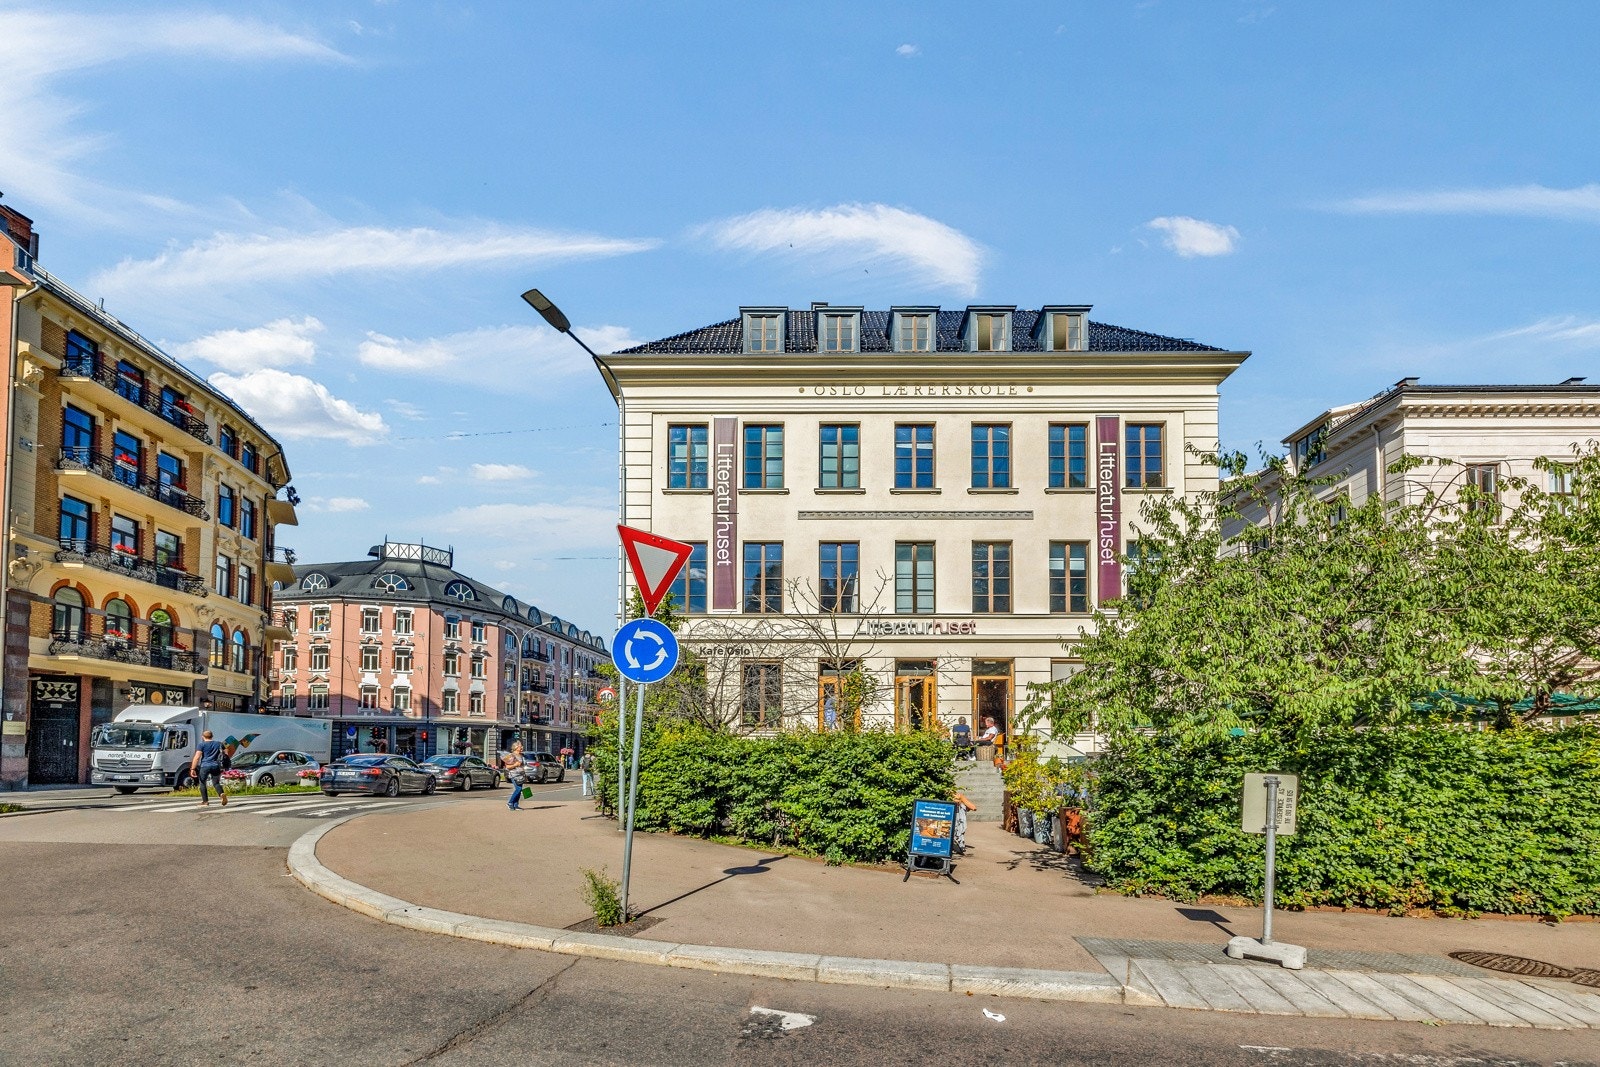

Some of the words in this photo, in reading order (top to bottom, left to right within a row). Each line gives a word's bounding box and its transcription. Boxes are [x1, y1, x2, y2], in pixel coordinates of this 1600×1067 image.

[814, 385, 866, 396] OSLO
[882, 384, 1018, 396] LÆRERSKOLE
[717, 443, 734, 566] Litteraturhuset
[1100, 442, 1118, 566] Litteraturhuset
[857, 619, 977, 635] Litteraturhuset
[700, 646, 724, 656] Kafe
[727, 646, 750, 656] Oslo
